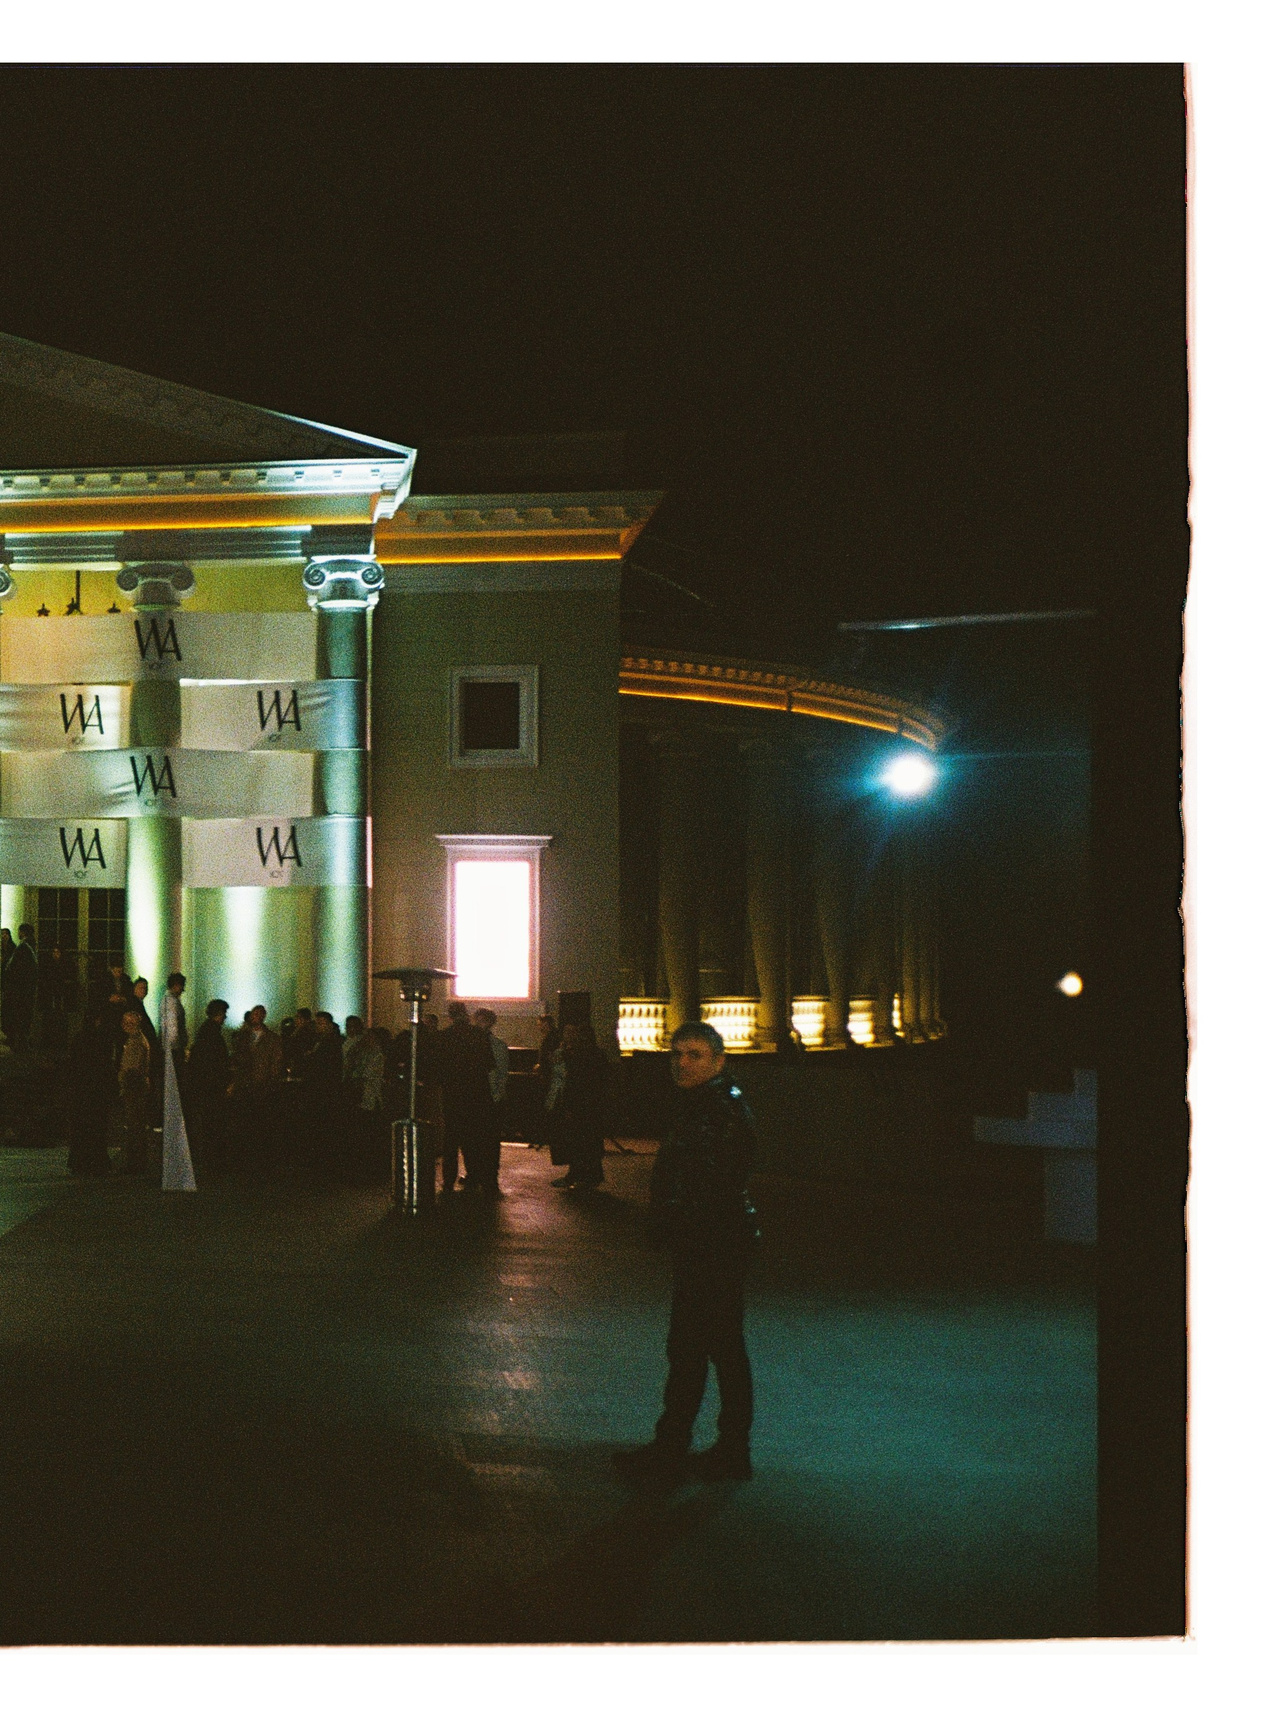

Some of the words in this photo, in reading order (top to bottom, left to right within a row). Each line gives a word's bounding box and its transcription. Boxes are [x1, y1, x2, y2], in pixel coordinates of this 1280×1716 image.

[134, 618, 182, 661] WA
[59, 693, 105, 734] WA
[257, 690, 302, 732] WA
[130, 755, 177, 799] WA
[59, 827, 107, 869] WA
[256, 825, 303, 868] WA
